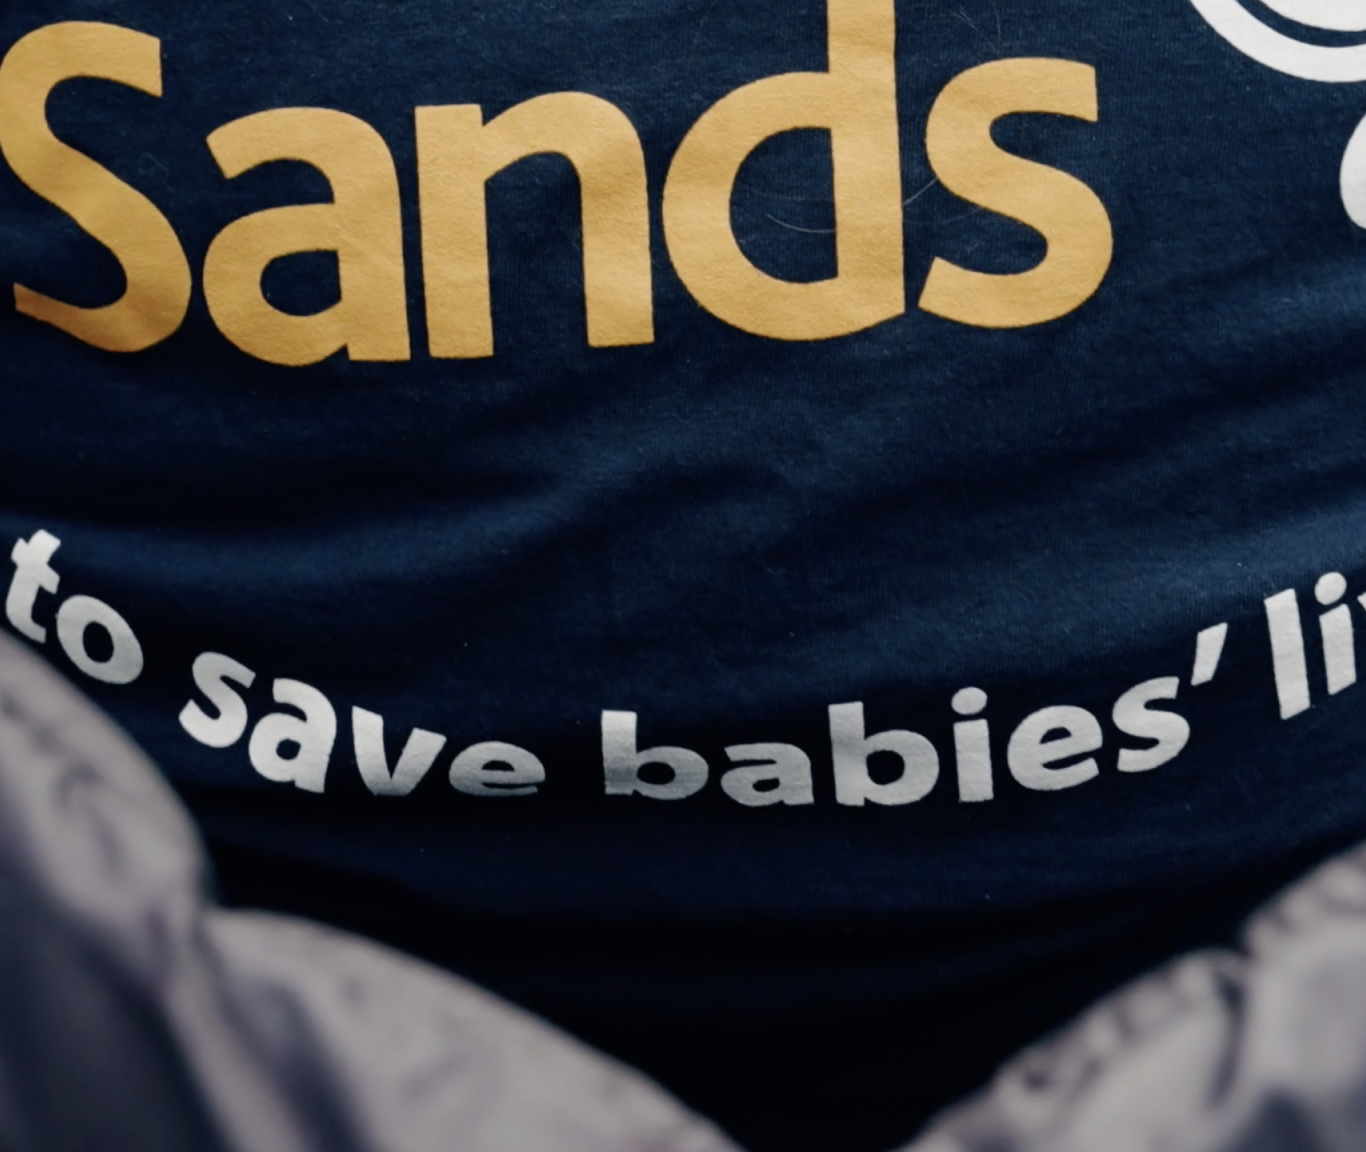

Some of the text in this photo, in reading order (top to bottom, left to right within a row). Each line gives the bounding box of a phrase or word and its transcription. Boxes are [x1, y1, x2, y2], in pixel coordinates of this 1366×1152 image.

[4, 528, 145, 685] to
[178, 651, 547, 796] save
[600, 622, 1229, 807] babies'
